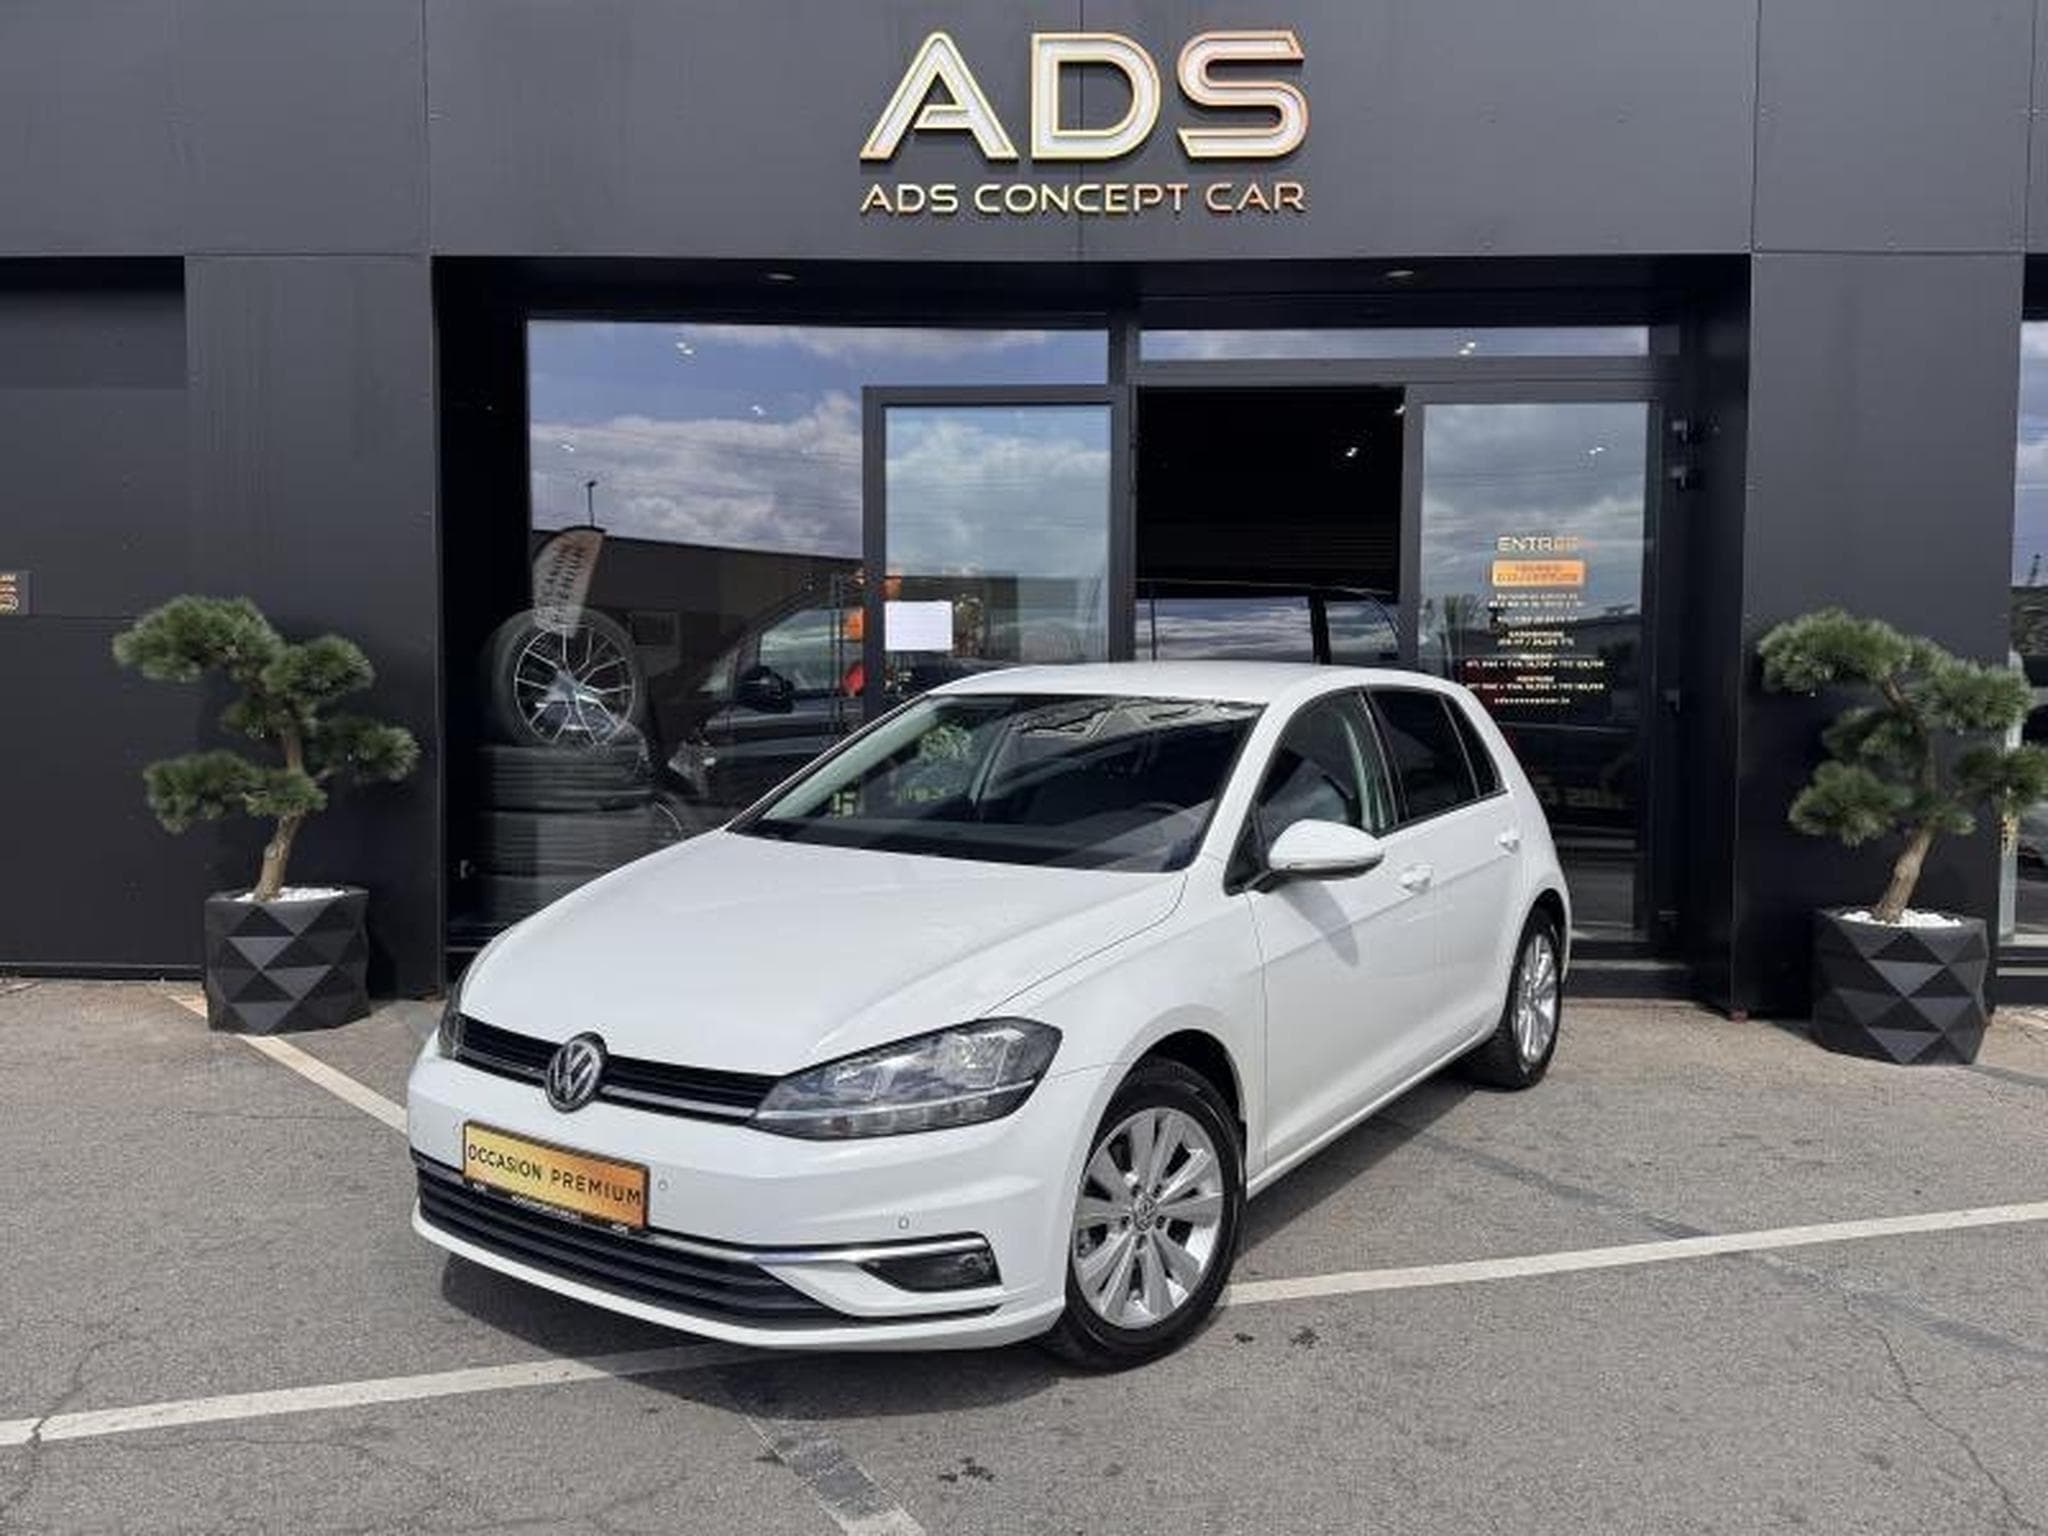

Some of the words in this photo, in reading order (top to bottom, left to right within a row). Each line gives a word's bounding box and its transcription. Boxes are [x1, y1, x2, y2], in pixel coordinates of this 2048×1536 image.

[859, 30, 1310, 160] ADS
[859, 182, 958, 214] ADS
[974, 182, 1189, 214] CONCEPT
[1206, 180, 1308, 212] CAR
[467, 1142, 543, 1182] OCCASION
[551, 1168, 642, 1207] PREMIUM
